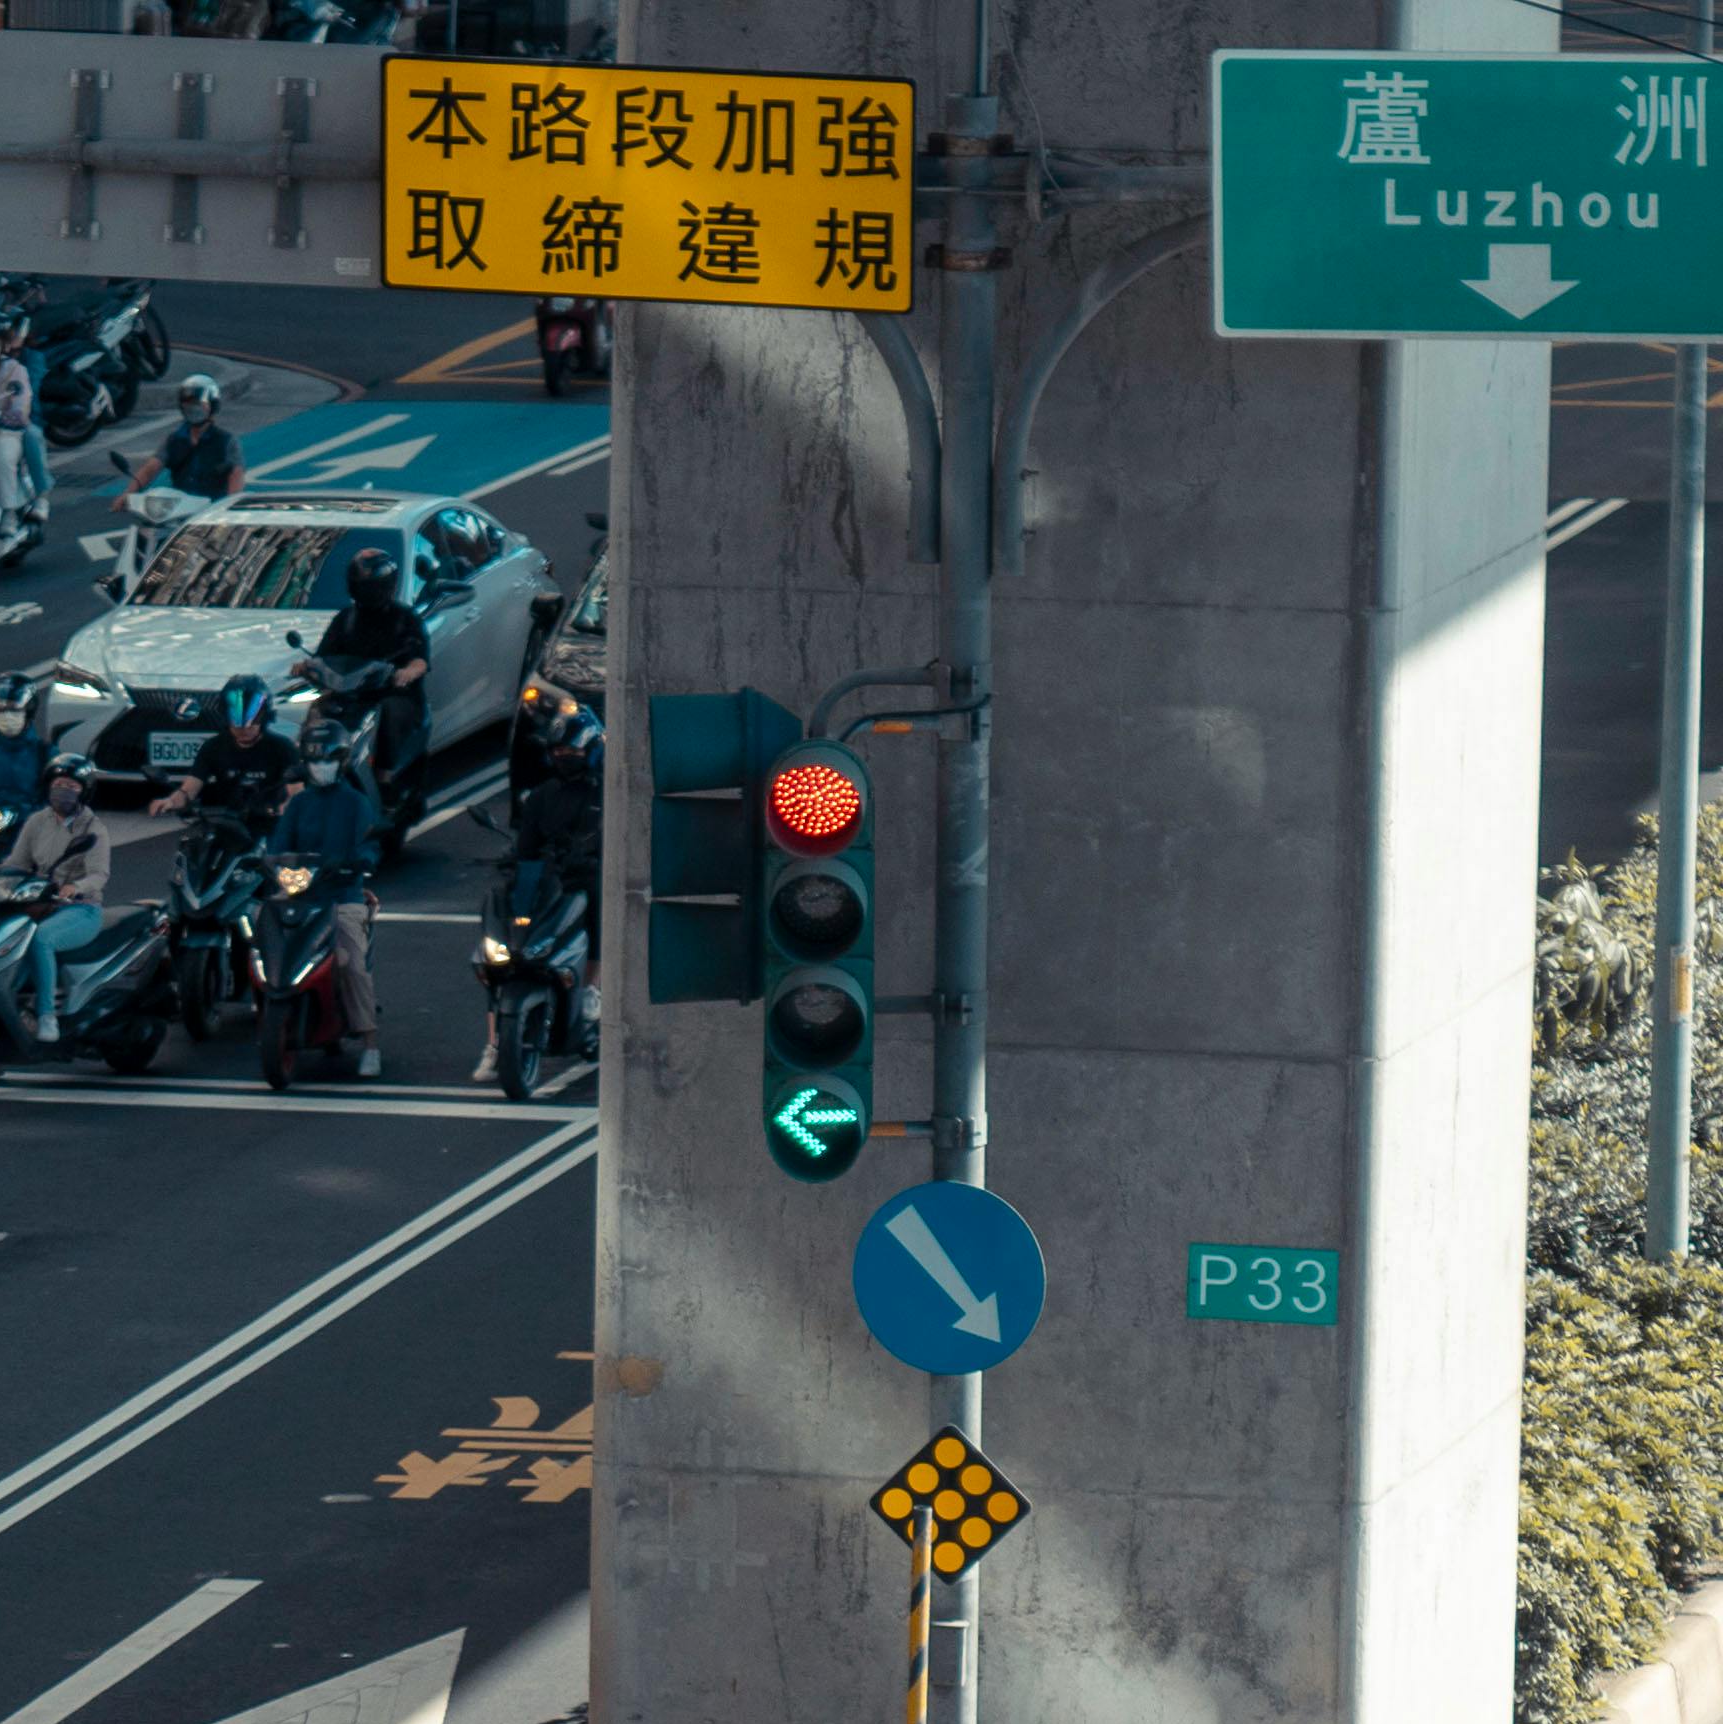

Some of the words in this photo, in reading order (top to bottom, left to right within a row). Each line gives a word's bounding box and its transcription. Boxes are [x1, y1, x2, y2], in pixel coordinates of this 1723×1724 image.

[407, 77, 900, 180] 本路段加強
[1336, 71, 1708, 167] 蘆洲
[407, 189, 897, 290] 取締違規
[1384, 177, 1660, 228] Luzhou
[1199, 1254, 1327, 1314] P33
